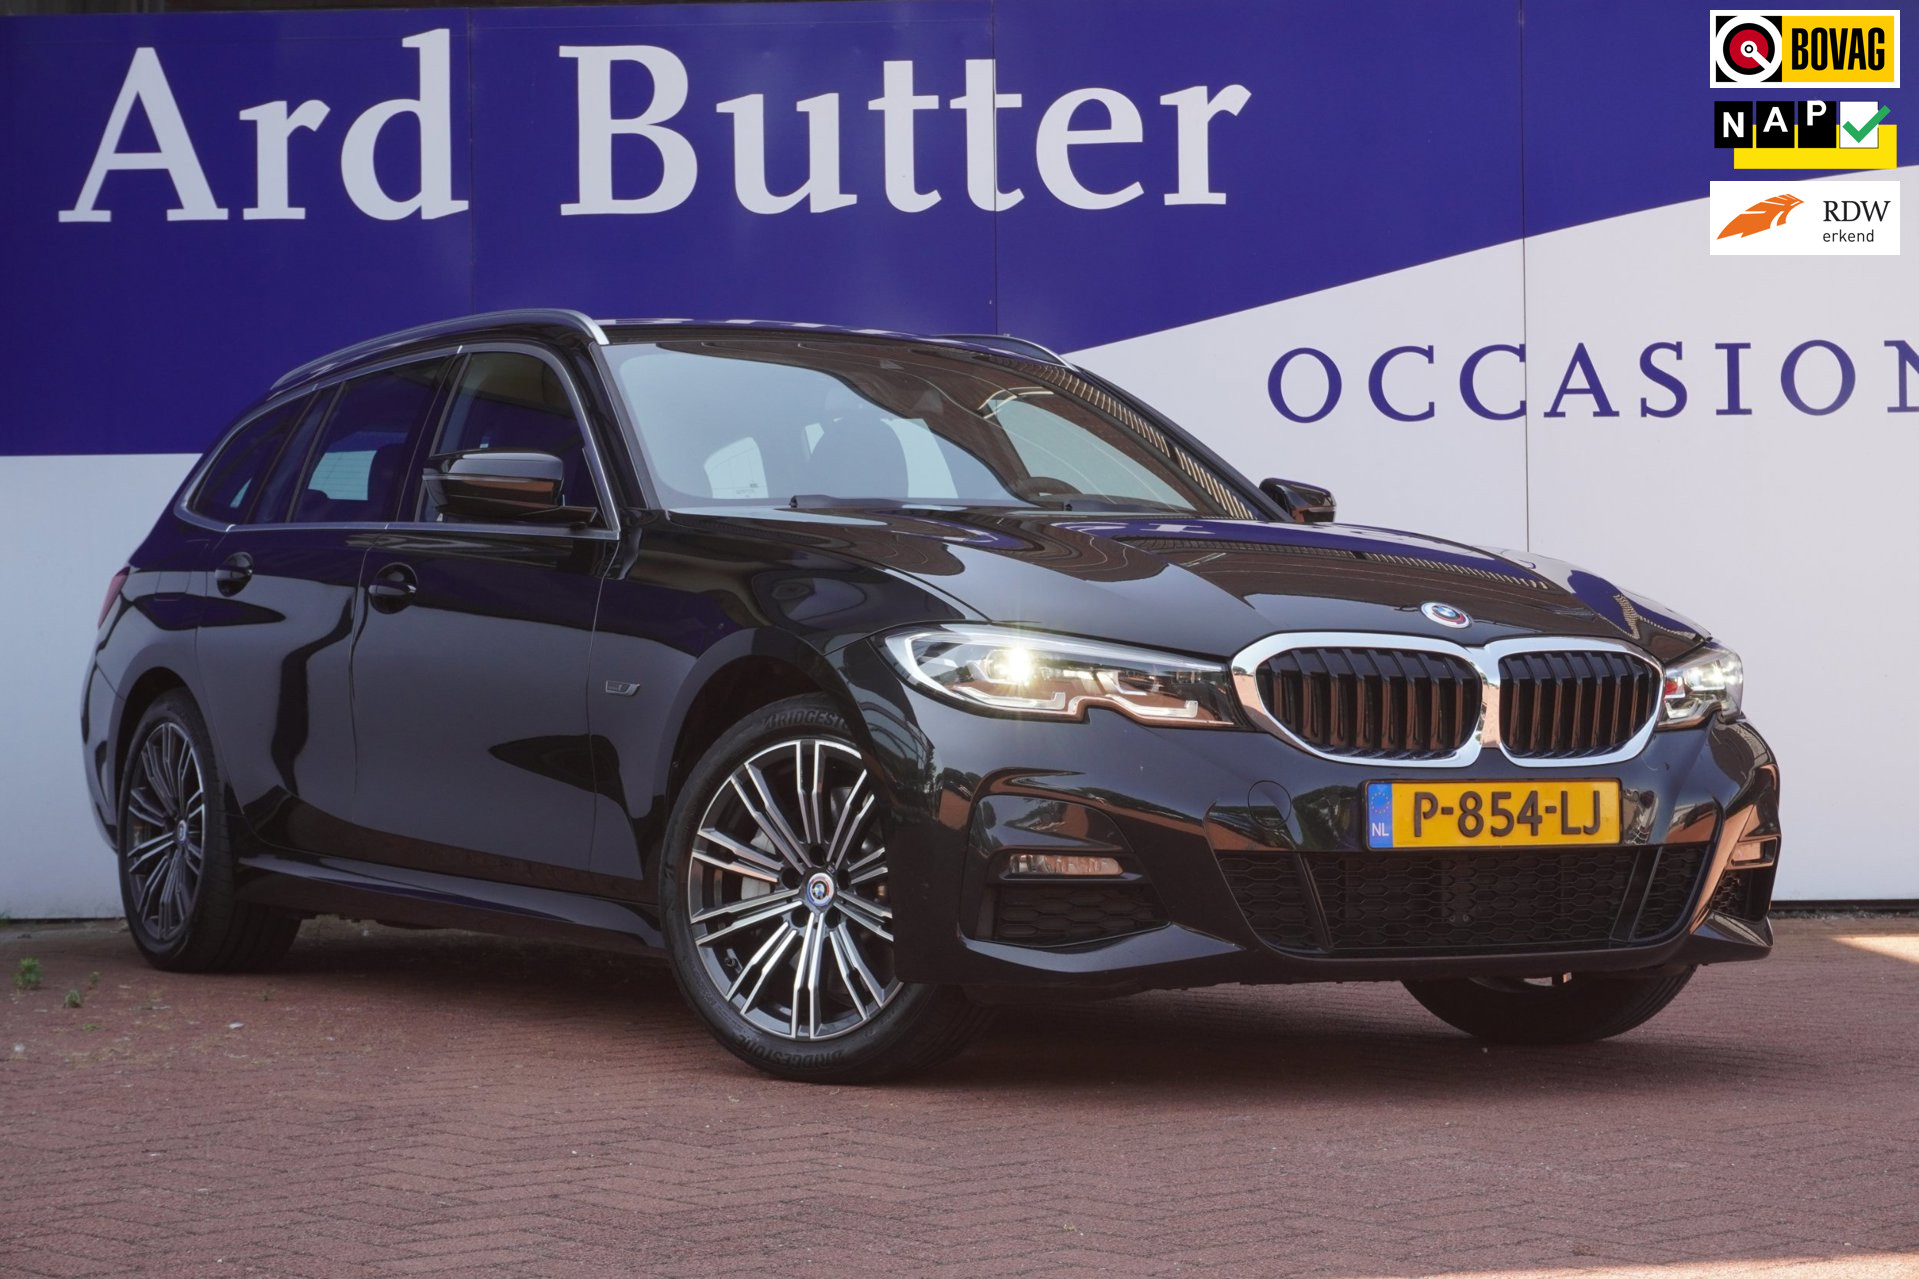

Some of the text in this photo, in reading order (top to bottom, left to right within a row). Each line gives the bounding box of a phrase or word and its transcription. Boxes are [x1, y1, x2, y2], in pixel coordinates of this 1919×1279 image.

[59, 28, 1251, 222] Ard Butter
[762, 709, 849, 729] BRIDGEST
[1371, 822, 1390, 837] NL
[1414, 790, 1601, 838] P-854-LJ
